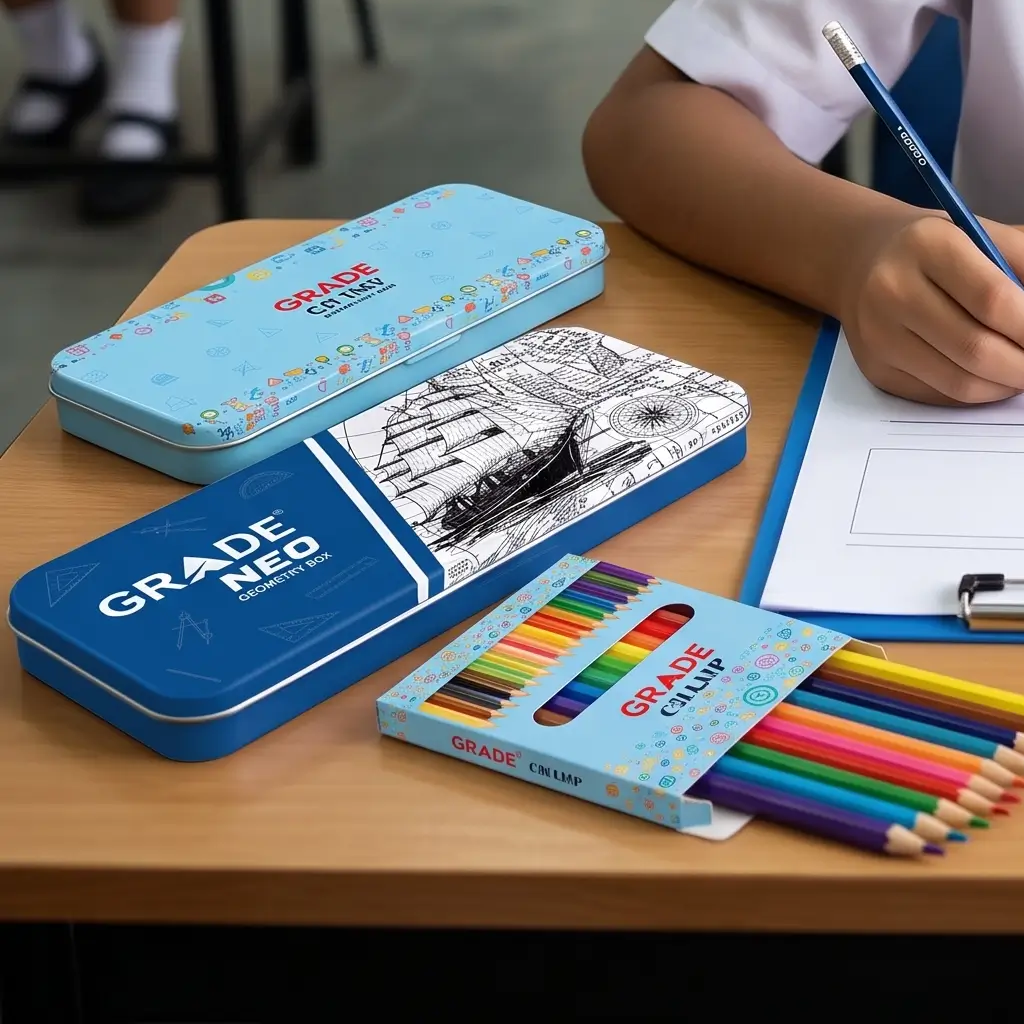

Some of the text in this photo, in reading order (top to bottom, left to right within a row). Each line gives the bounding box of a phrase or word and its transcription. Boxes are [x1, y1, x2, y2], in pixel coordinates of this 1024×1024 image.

[274, 263, 379, 311] GRADE
[219, 536, 320, 592] NEO
[238, 551, 333, 602] GEOMETRY BOX
[620, 643, 714, 717] GRADE
[452, 735, 517, 768] GRADE
